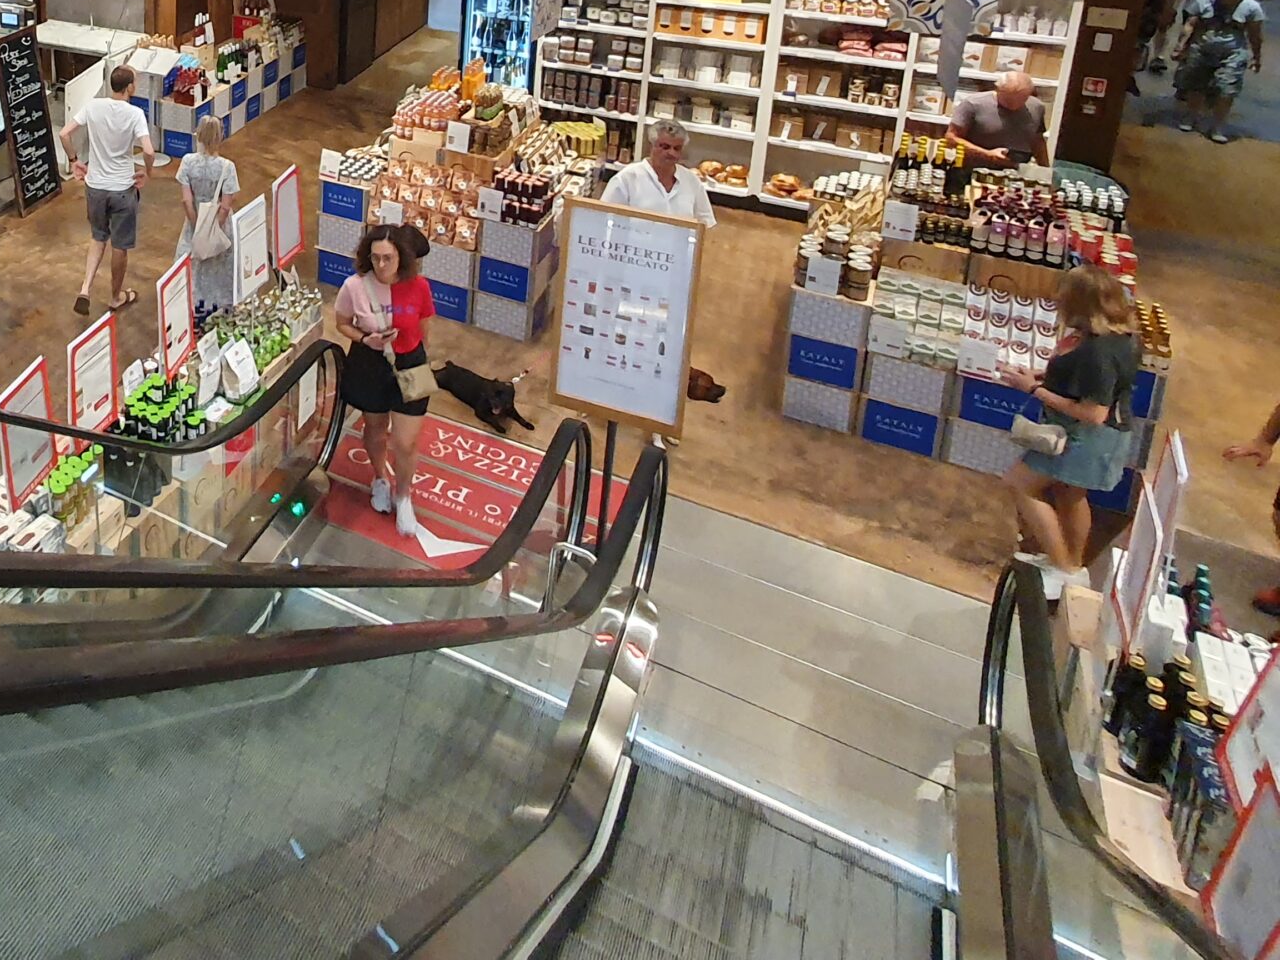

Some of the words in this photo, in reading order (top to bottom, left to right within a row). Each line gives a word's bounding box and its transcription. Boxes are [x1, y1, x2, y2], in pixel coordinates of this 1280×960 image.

[328, 192, 357, 204] EATALY
[577, 234, 597, 248] LE
[601, 239, 676, 264] OFFERTE
[580, 246, 602, 258] DEL
[607, 252, 670, 273] MERCATO
[433, 291, 460, 304] ATALY
[799, 349, 846, 367] EATALY
[875, 414, 924, 432] EATALY
[347, 448, 473, 504] PIAO
